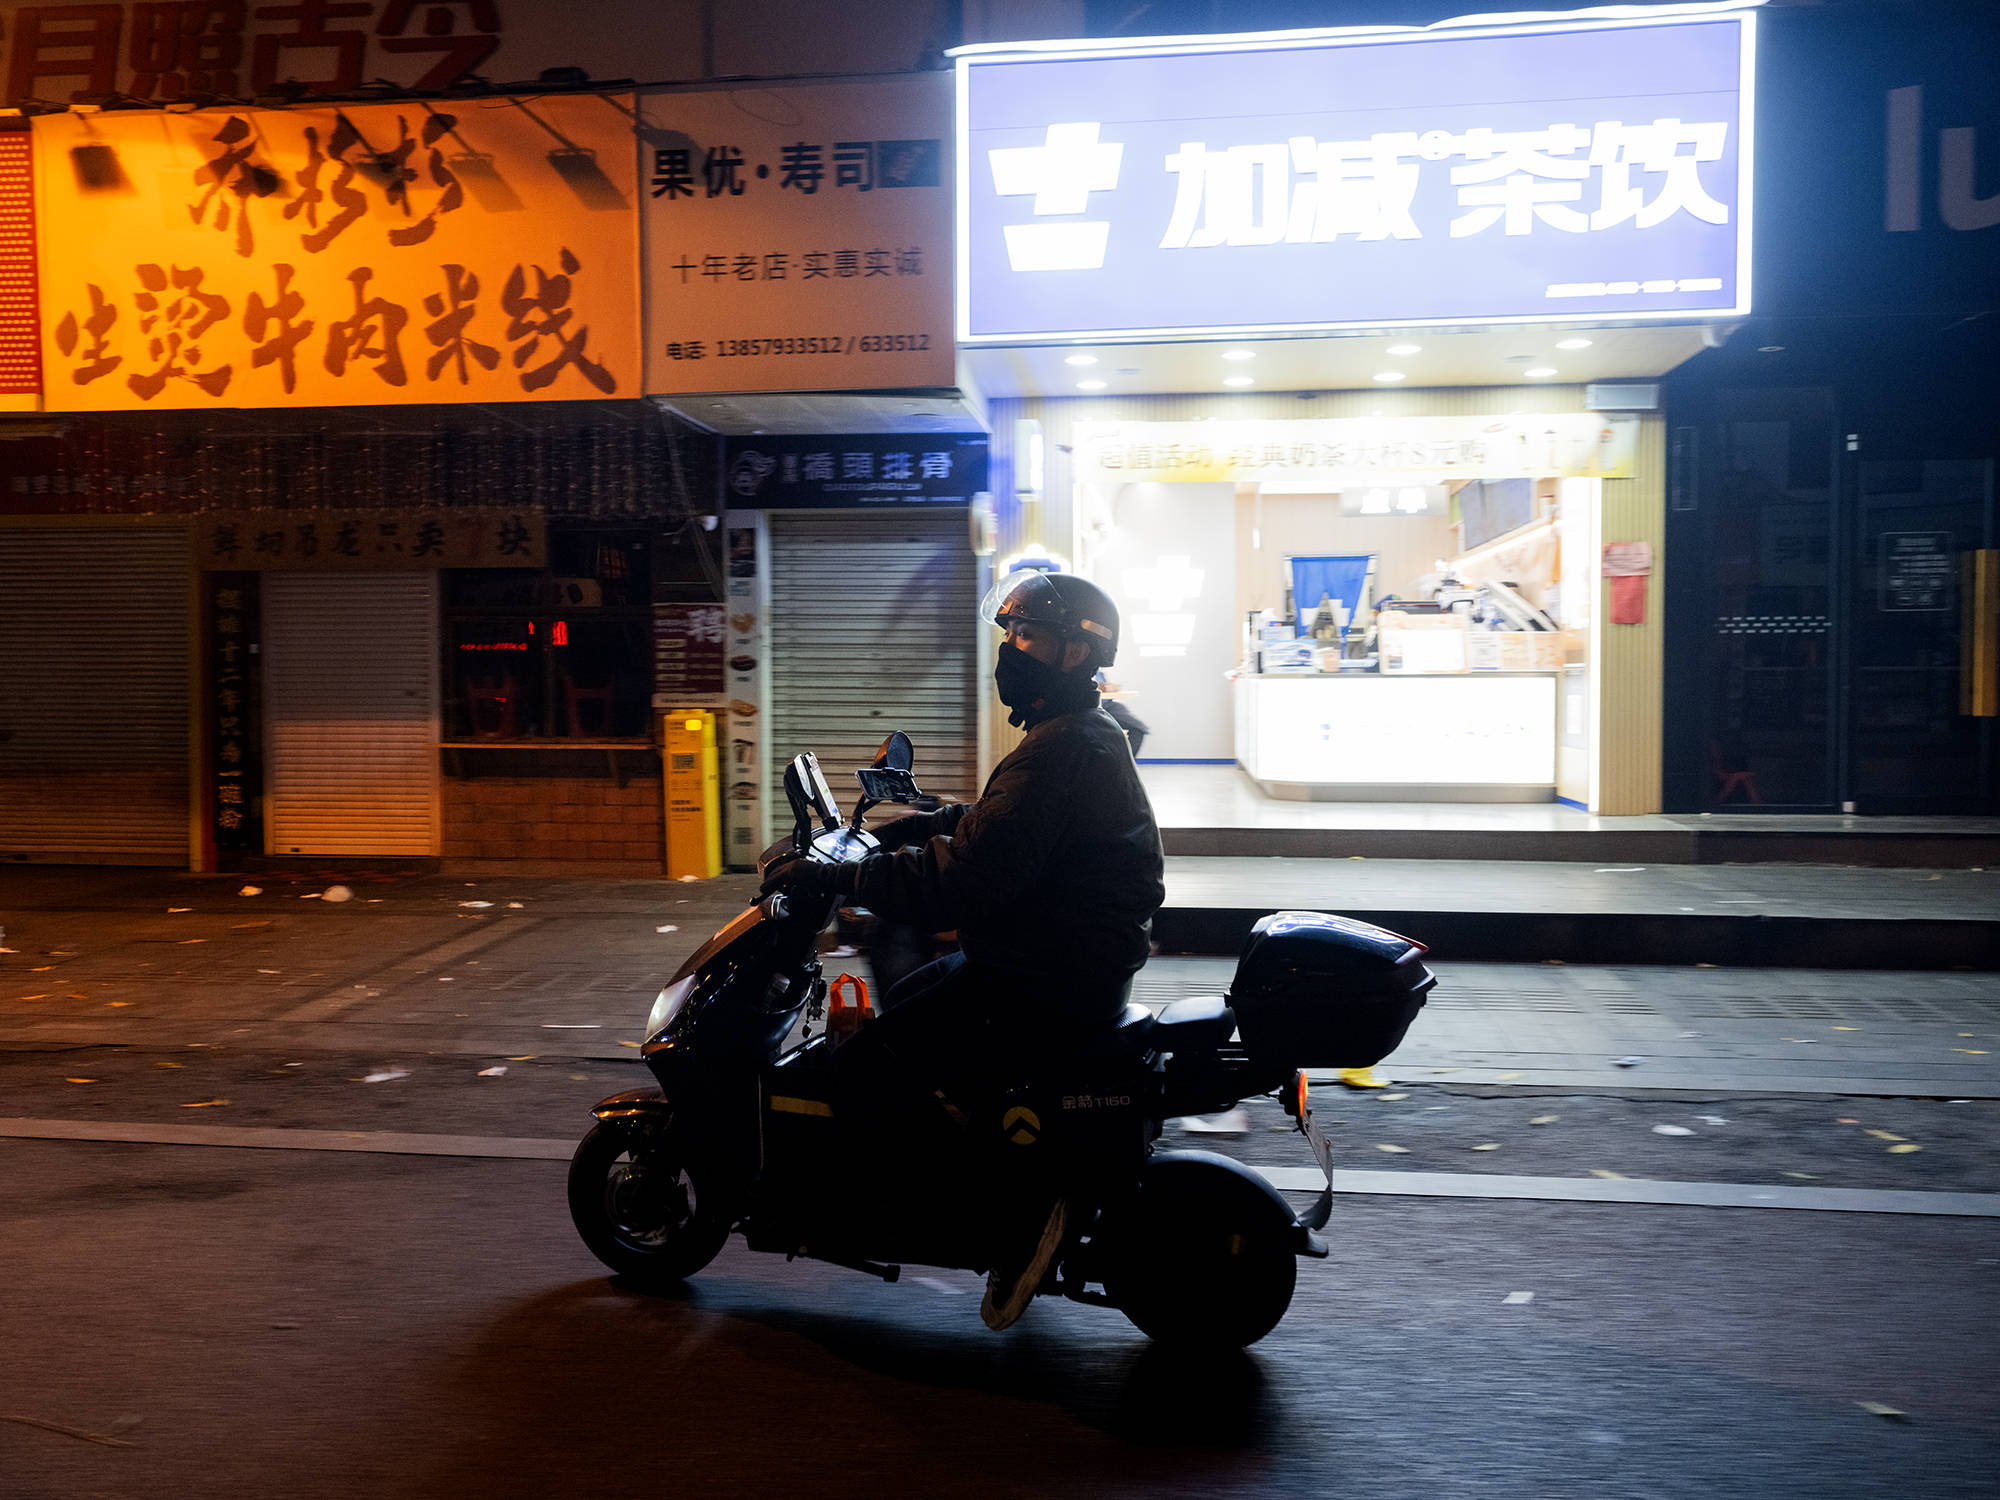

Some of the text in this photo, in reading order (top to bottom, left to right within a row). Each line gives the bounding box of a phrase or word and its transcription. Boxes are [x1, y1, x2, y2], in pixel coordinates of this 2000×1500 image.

[55, 247, 617, 401] 生烫牛肉米线
[717, 336, 841, 357] 13857933512
[860, 334, 930, 354] 633512
